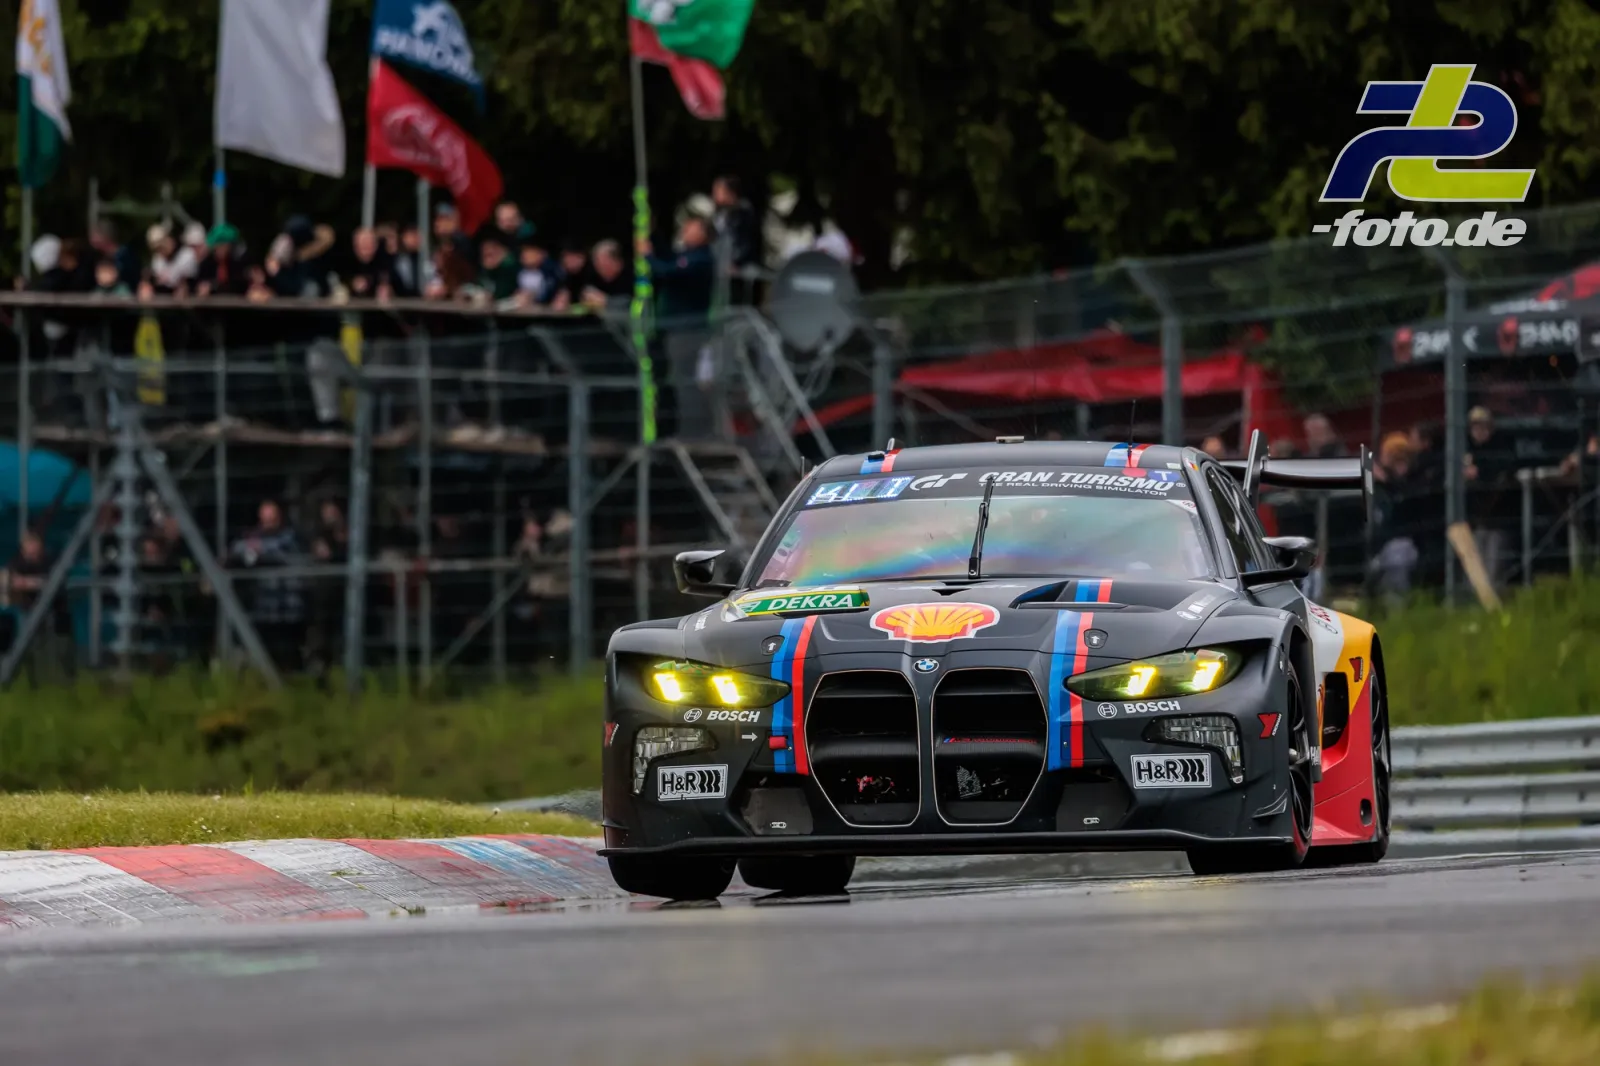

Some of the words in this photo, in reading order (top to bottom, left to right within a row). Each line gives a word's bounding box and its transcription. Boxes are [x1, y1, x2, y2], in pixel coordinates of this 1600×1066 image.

[978, 471, 1055, 483] GRAN
[1095, 484, 1168, 497] SIMULATOR
[767, 594, 854, 611] DEKRA
[1123, 700, 1181, 714] BOSCH
[706, 710, 761, 723] BOSCH
[1136, 760, 1180, 781] H&R
[661, 772, 698, 793] H&R
